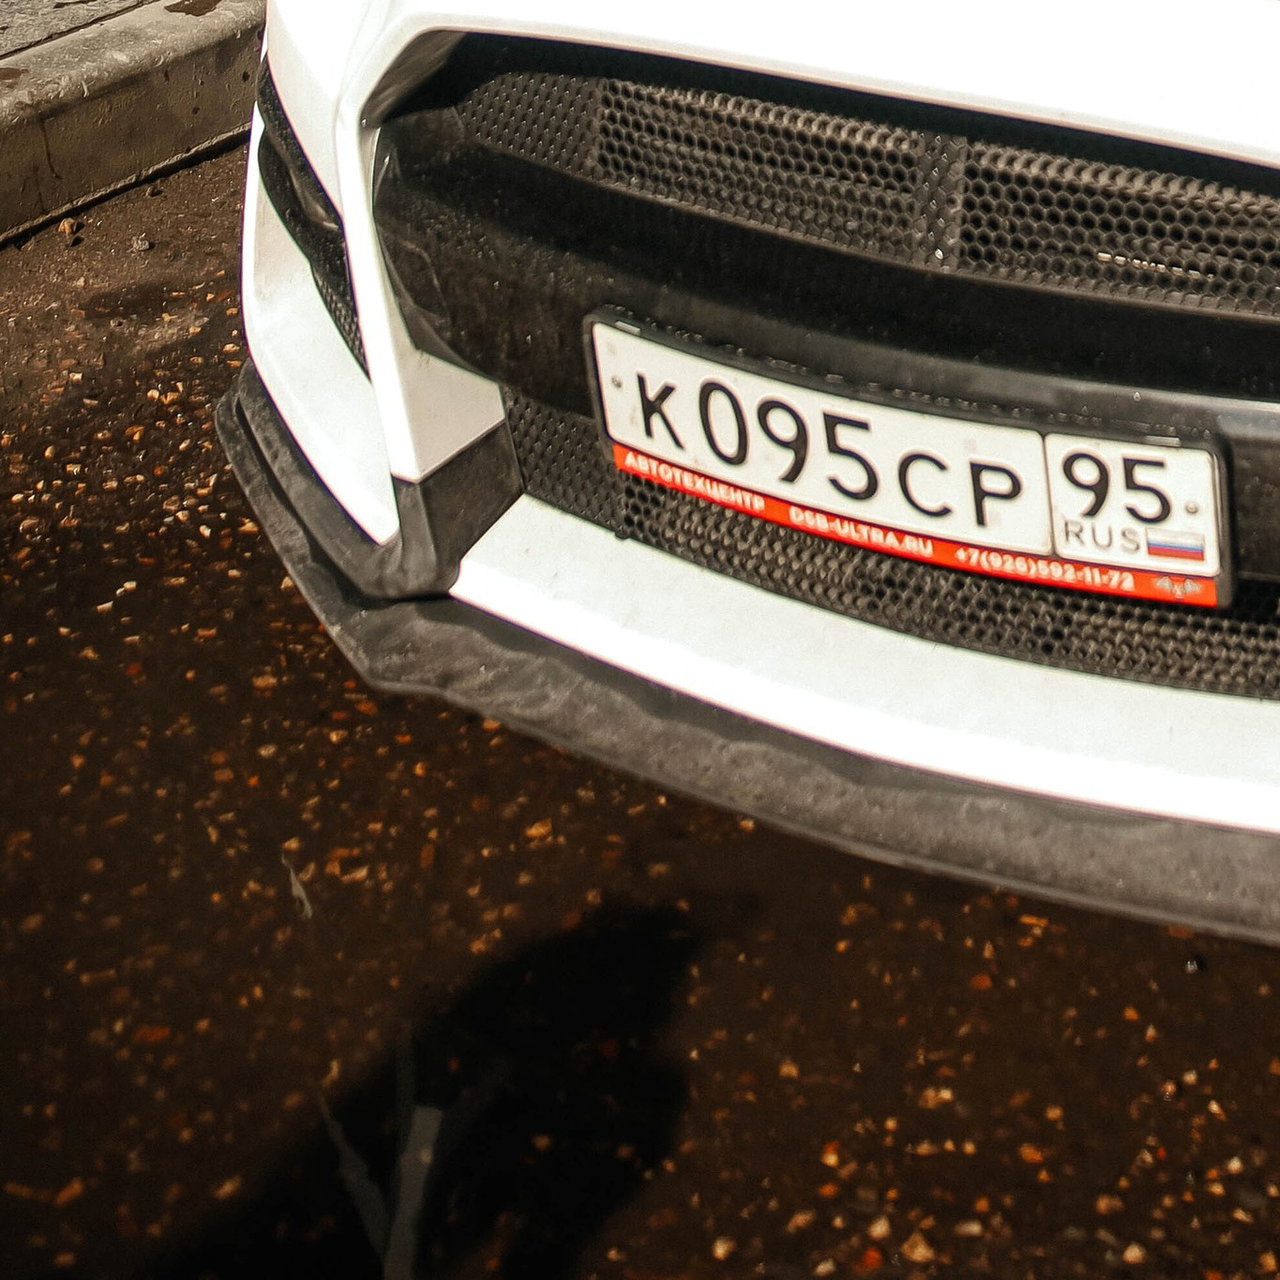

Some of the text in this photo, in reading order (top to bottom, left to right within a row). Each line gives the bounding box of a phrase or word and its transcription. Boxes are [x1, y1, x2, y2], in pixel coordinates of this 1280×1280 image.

[624, 450, 766, 514] АВТОТЕХЦЕНТР
[789, 505, 934, 558] DSB-ULTRA.RU
[1063, 452, 1171, 523] 95
[1064, 520, 1141, 553] RUS
